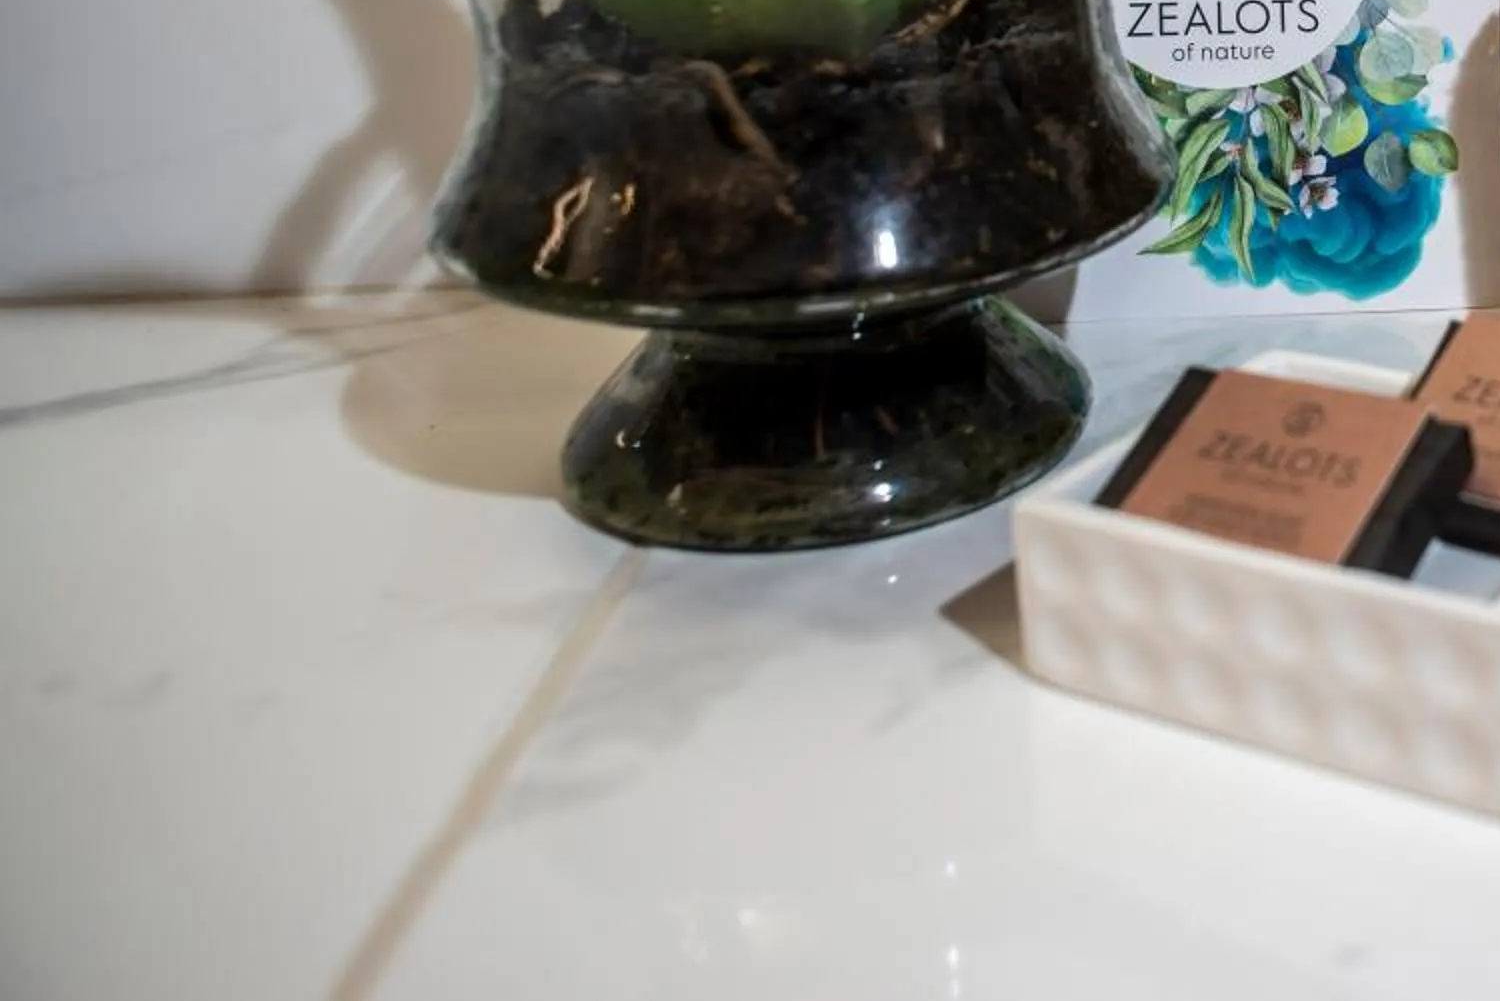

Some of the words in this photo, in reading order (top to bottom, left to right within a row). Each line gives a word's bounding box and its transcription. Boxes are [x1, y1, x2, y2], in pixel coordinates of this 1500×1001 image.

[1172, 43, 1198, 62] of
[1200, 43, 1275, 60] nature
[1196, 429, 1363, 489] ZEALOTS
